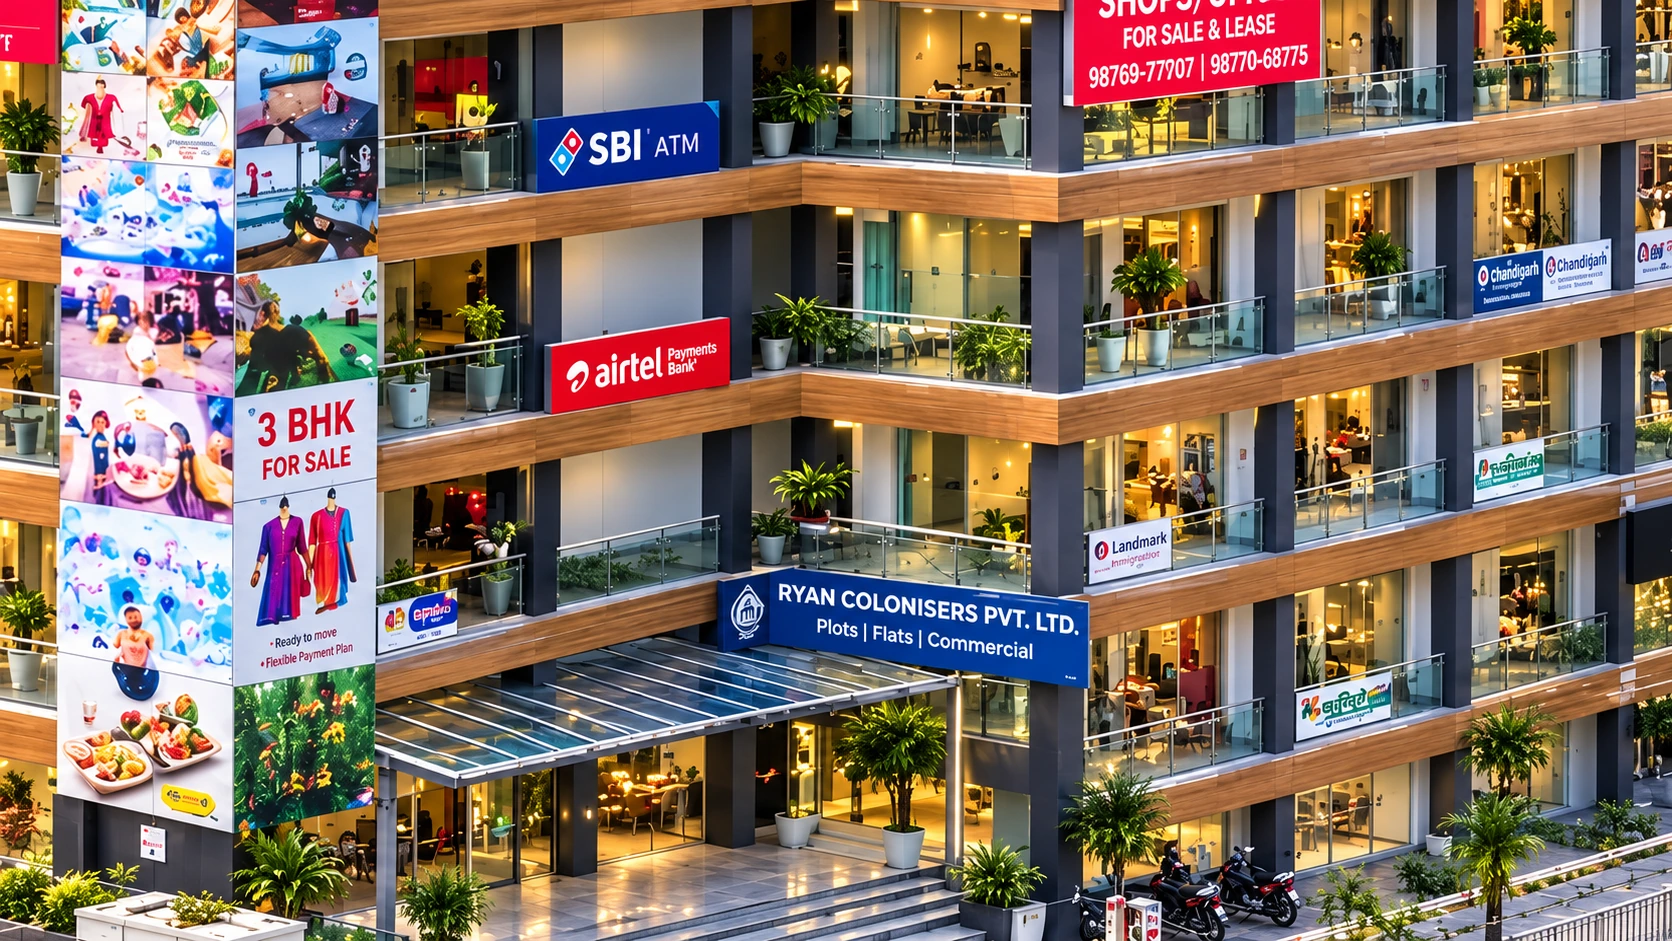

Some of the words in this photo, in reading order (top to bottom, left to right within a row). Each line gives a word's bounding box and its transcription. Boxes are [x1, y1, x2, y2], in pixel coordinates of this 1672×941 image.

[1123, 26, 1156, 49] FOR
[1161, 21, 1203, 45] SALE
[1208, 18, 1220, 40] &
[1225, 13, 1275, 39] LEASE
[1210, 44, 1308, 75] 98770-68775
[588, 128, 641, 166] SBI
[654, 132, 698, 157] ATM
[595, 346, 663, 388] airtel
[668, 342, 717, 362] Payments
[258, 412, 276, 447] 3
[288, 398, 355, 443] BHK
[262, 454, 300, 480] FOR
[305, 445, 351, 473] SALE
[1112, 531, 1167, 554] Landmark
[779, 583, 835, 607] RYAN
[841, 590, 978, 623] COLONISERS
[984, 605, 1030, 629] PVT.
[1036, 612, 1079, 636] LTD.
[266, 653, 297, 668] Flexible
[299, 646, 334, 662] Payment
[336, 643, 353, 655] Plan
[275, 634, 301, 649] Ready
[303, 633, 312, 643] to
[314, 628, 337, 641] move
[817, 618, 858, 638] Plots
[873, 625, 913, 645] Flats
[927, 632, 1033, 660] Commercial
